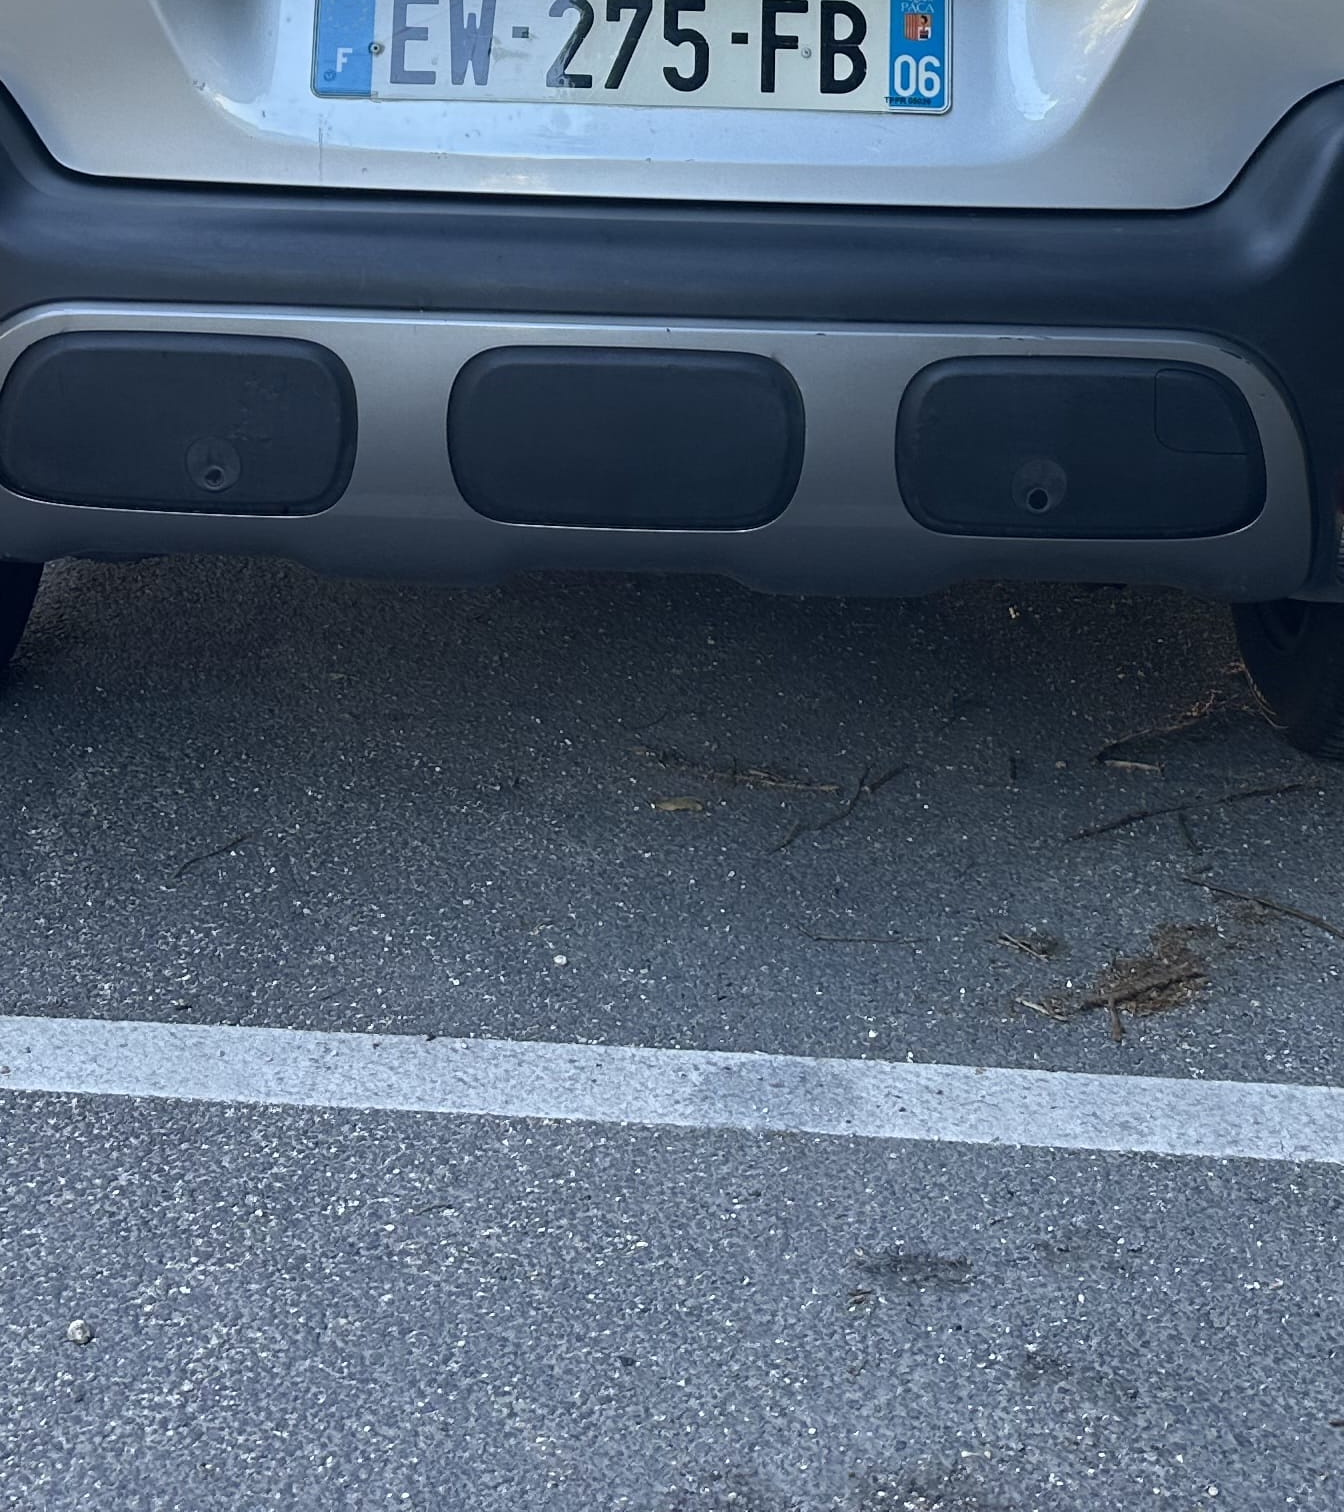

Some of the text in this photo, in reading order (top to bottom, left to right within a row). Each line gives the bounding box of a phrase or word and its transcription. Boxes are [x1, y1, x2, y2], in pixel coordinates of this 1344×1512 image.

[900, 2, 935, 13] PACA
[336, 47, 353, 73] F
[893, 54, 941, 98] 06
